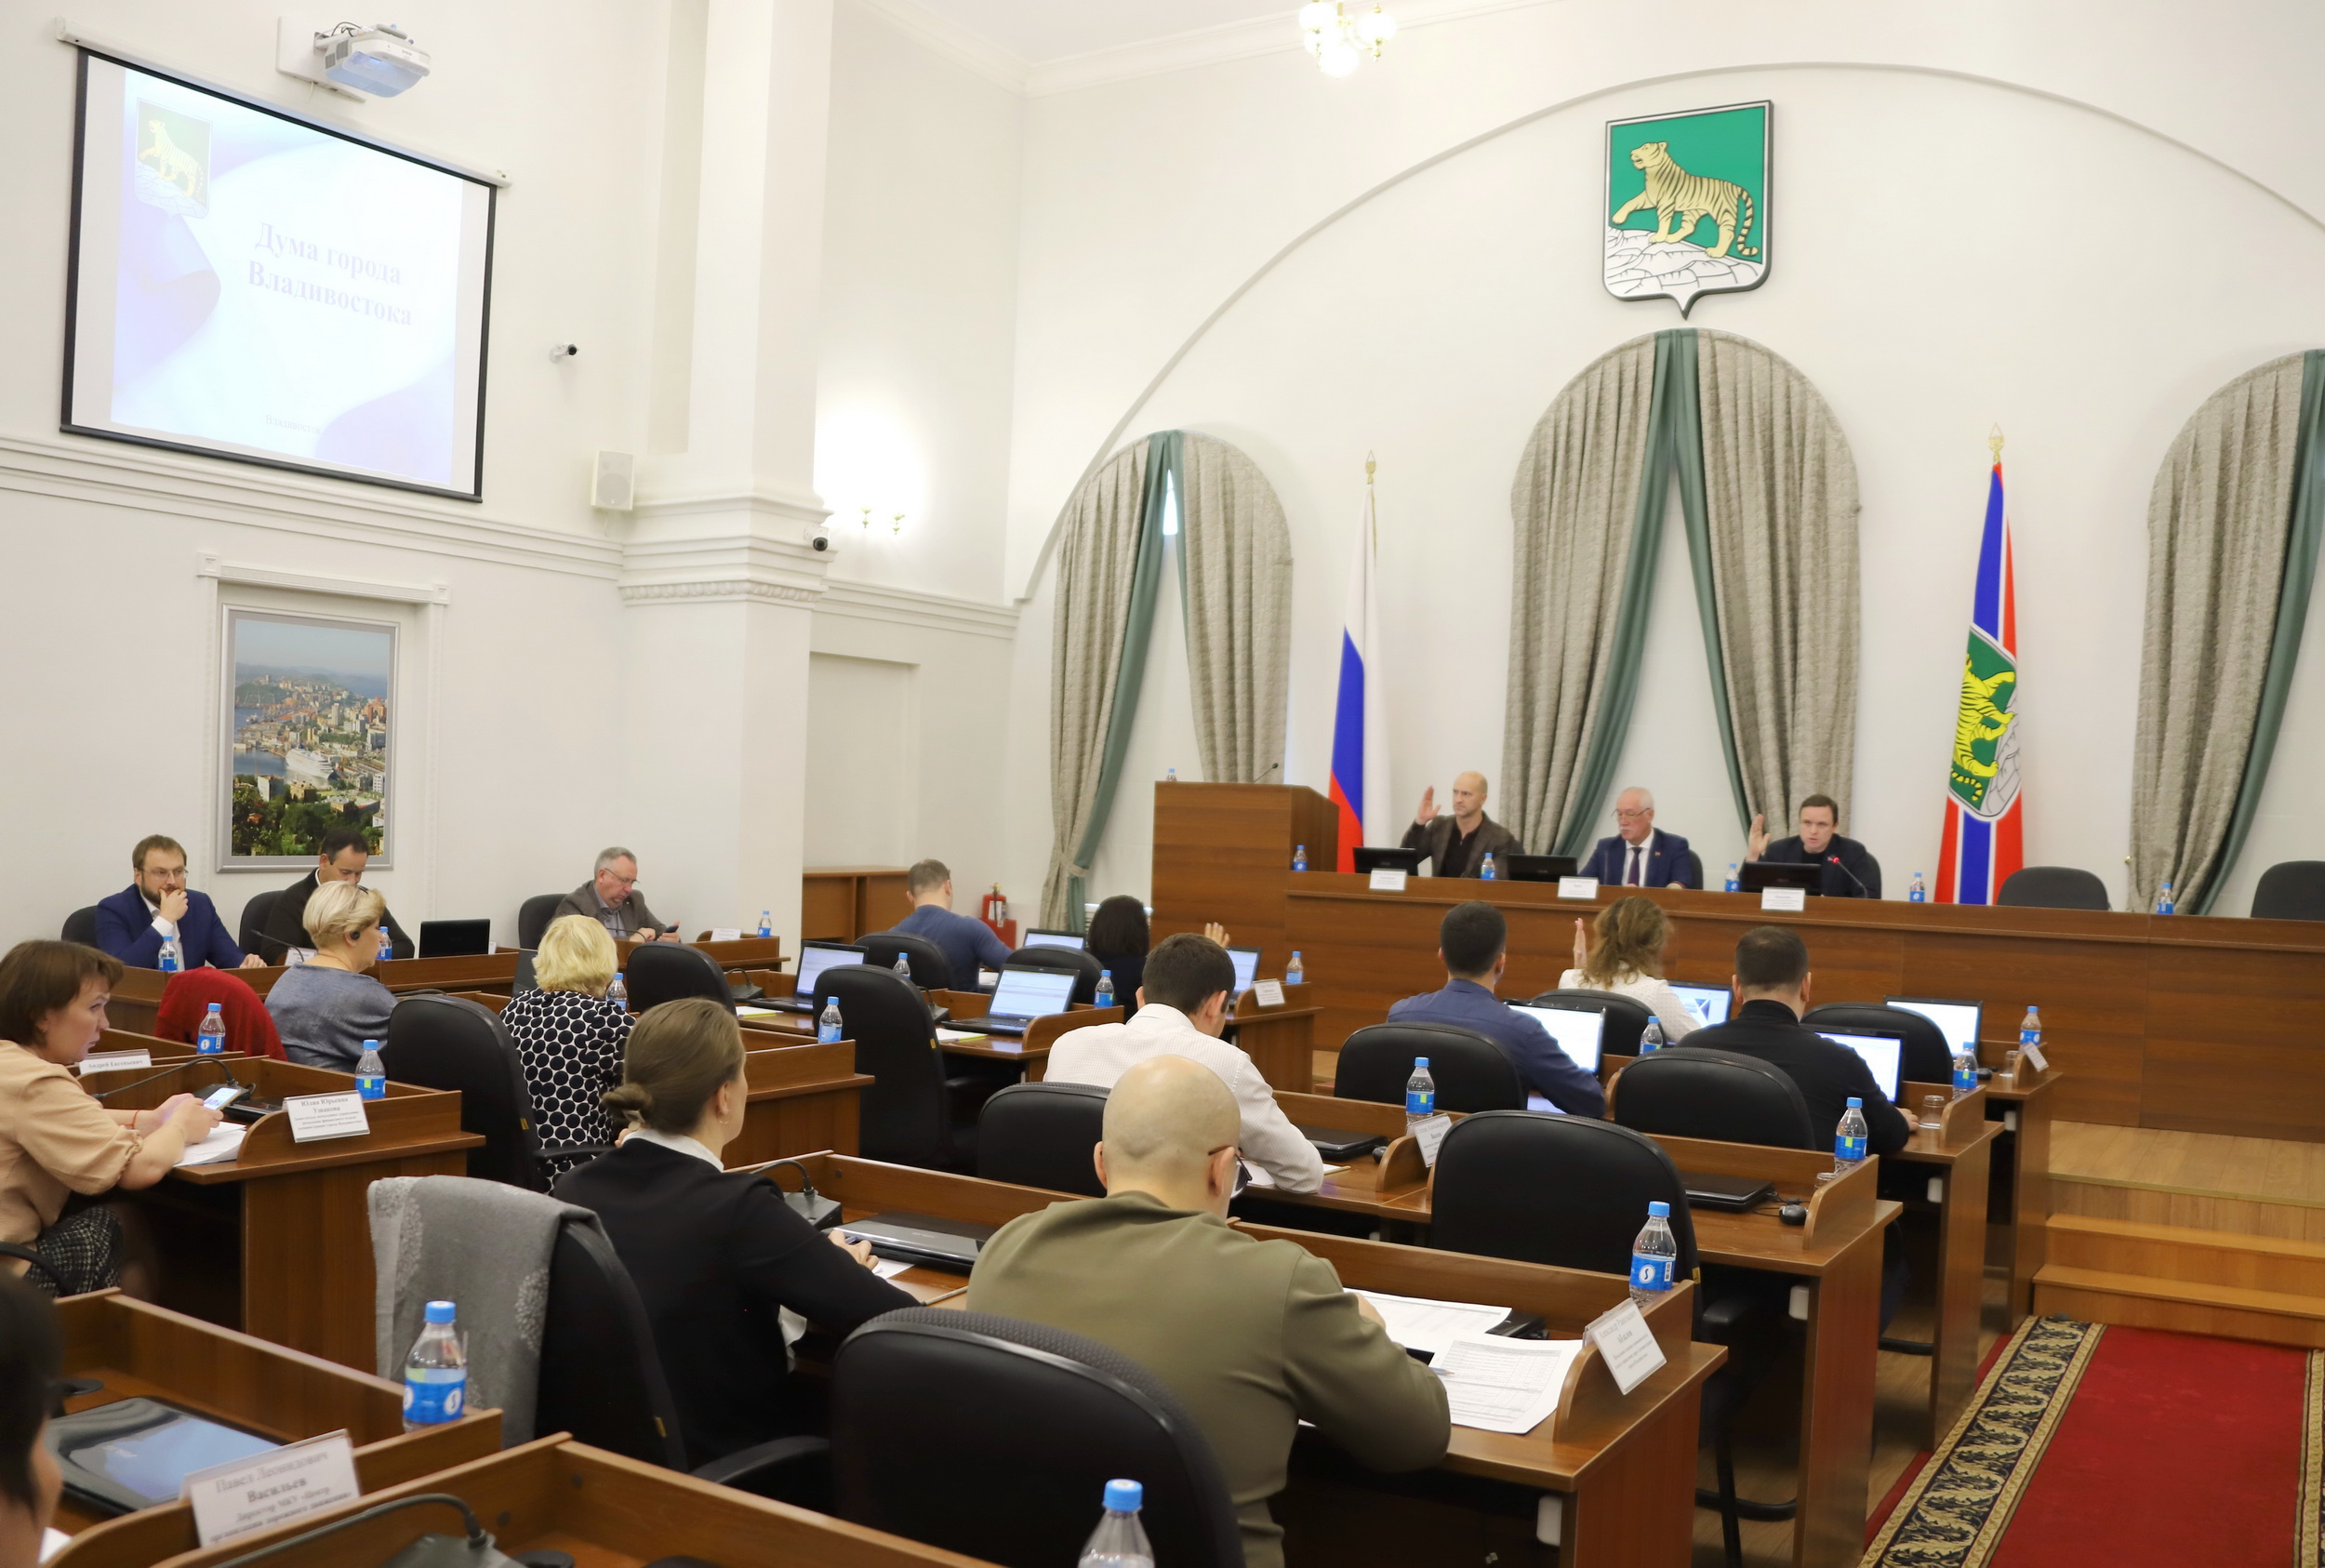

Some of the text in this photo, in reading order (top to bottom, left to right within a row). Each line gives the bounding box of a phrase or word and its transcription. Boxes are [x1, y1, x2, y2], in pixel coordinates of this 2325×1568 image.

[255, 222, 402, 285] Дума города
[247, 259, 412, 326] Владивостока
[312, 1106, 340, 1114] Ушакова
[320, 1096, 349, 1106] Юрьевна
[215, 1451, 328, 1494] Павел Леонидович
[246, 1477, 307, 1504] Васильев
